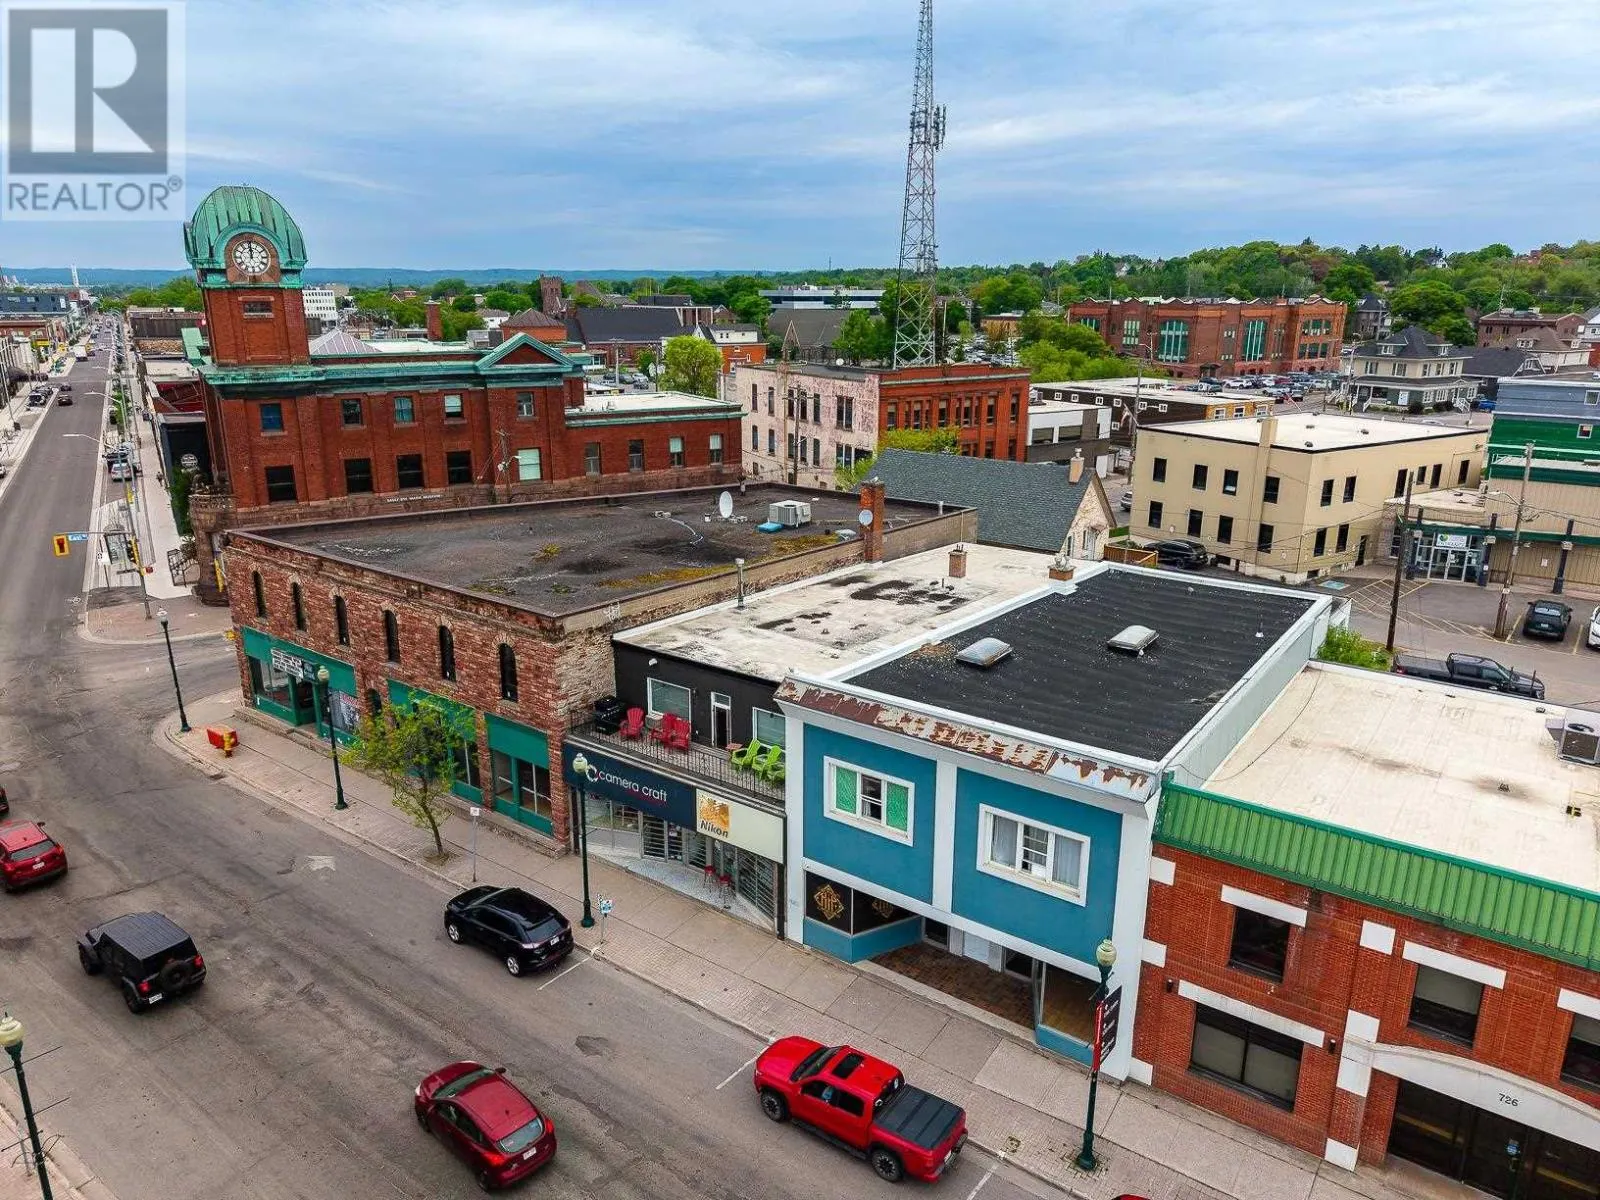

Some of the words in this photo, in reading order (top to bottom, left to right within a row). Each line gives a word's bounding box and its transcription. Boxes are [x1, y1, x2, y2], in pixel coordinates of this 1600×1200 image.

[598, 770, 639, 792] camera
[642, 786, 668, 802] craft
[700, 820, 729, 838] Nikon
[1499, 1093, 1519, 1107] 726
